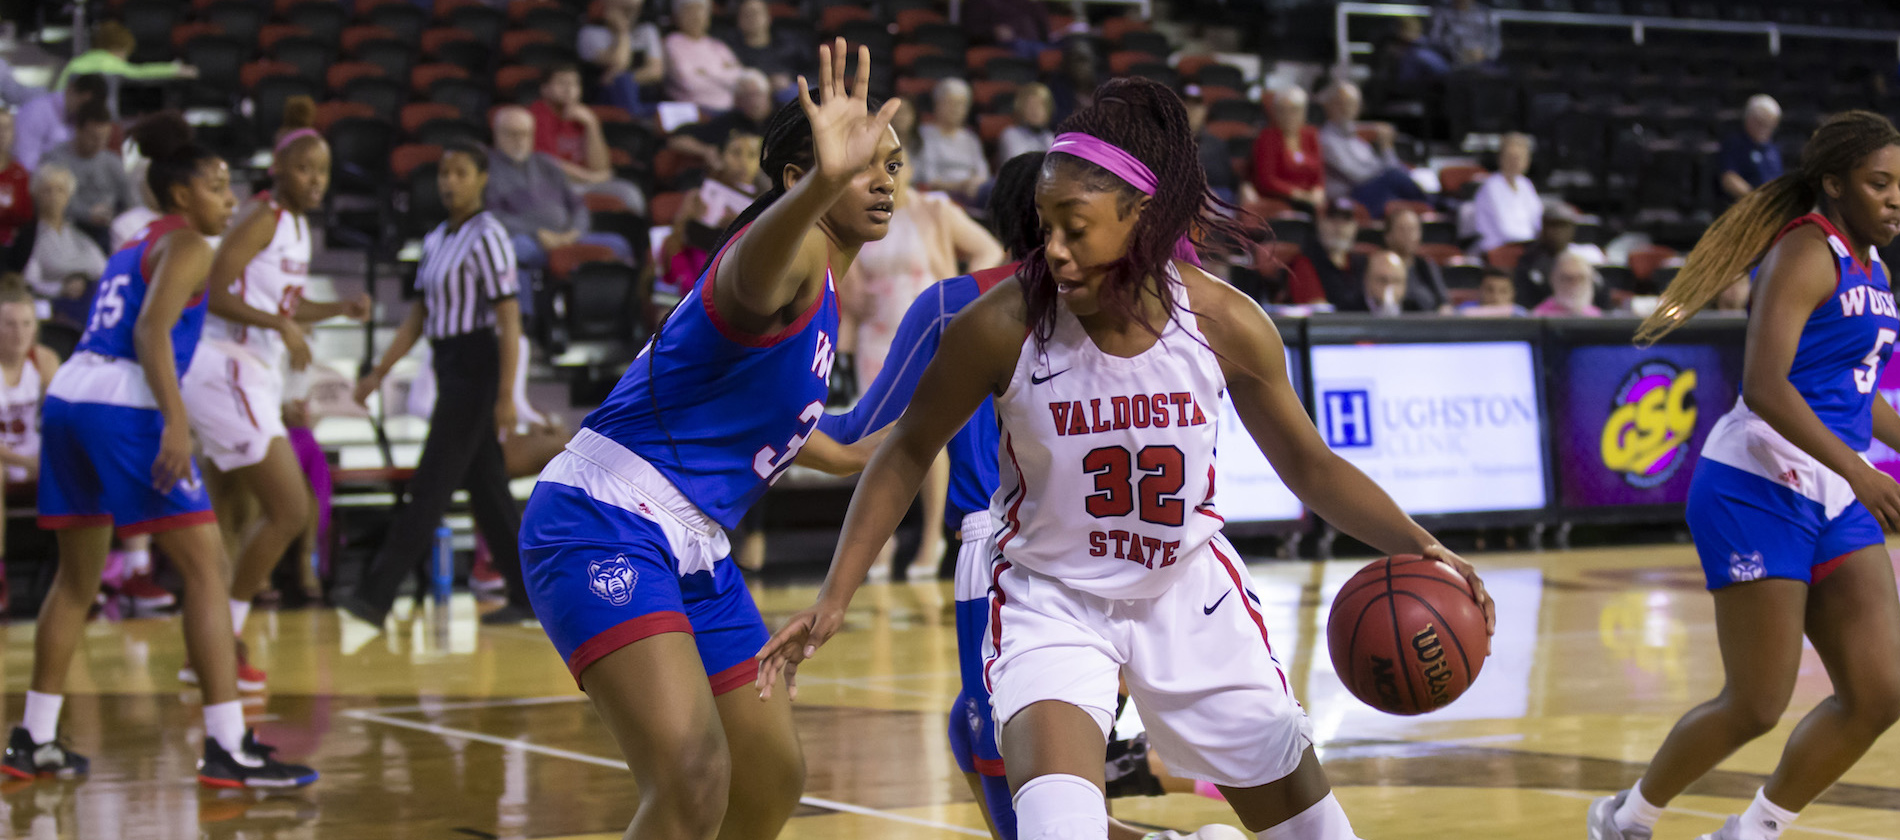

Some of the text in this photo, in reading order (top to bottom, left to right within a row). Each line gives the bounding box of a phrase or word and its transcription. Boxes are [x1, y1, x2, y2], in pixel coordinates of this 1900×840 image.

[1853, 327, 1897, 394] 5
[1049, 392, 1207, 436] VALDOSTA
[1601, 369, 1698, 475] GSC
[1083, 444, 1185, 527] 32
[1089, 530, 1180, 570] STATE
